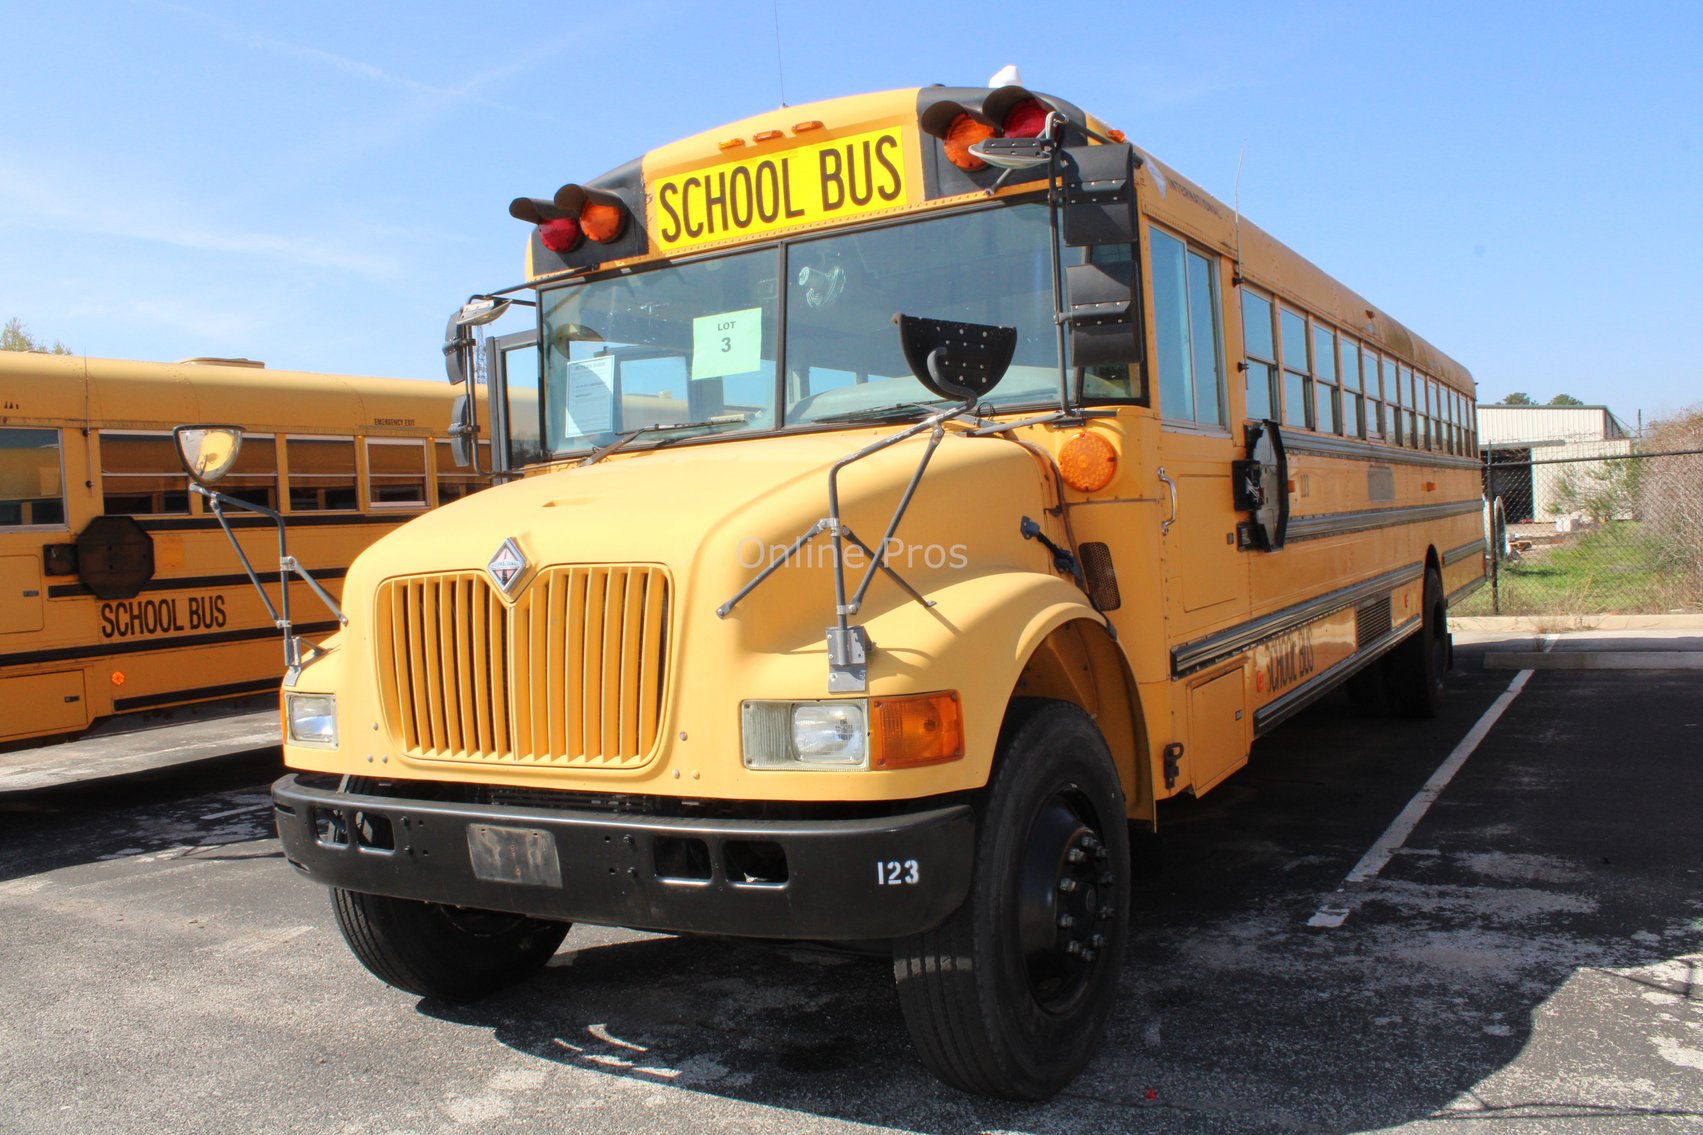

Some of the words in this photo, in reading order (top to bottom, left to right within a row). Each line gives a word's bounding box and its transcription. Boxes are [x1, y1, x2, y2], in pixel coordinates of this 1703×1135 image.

[659, 157, 805, 243] SCHOOL
[819, 134, 902, 212] BUS
[717, 320, 736, 331] LOT
[721, 336, 732, 353] 3
[101, 598, 184, 639] SCHOOL
[188, 594, 226, 630] BUS
[877, 859, 919, 885] 123
